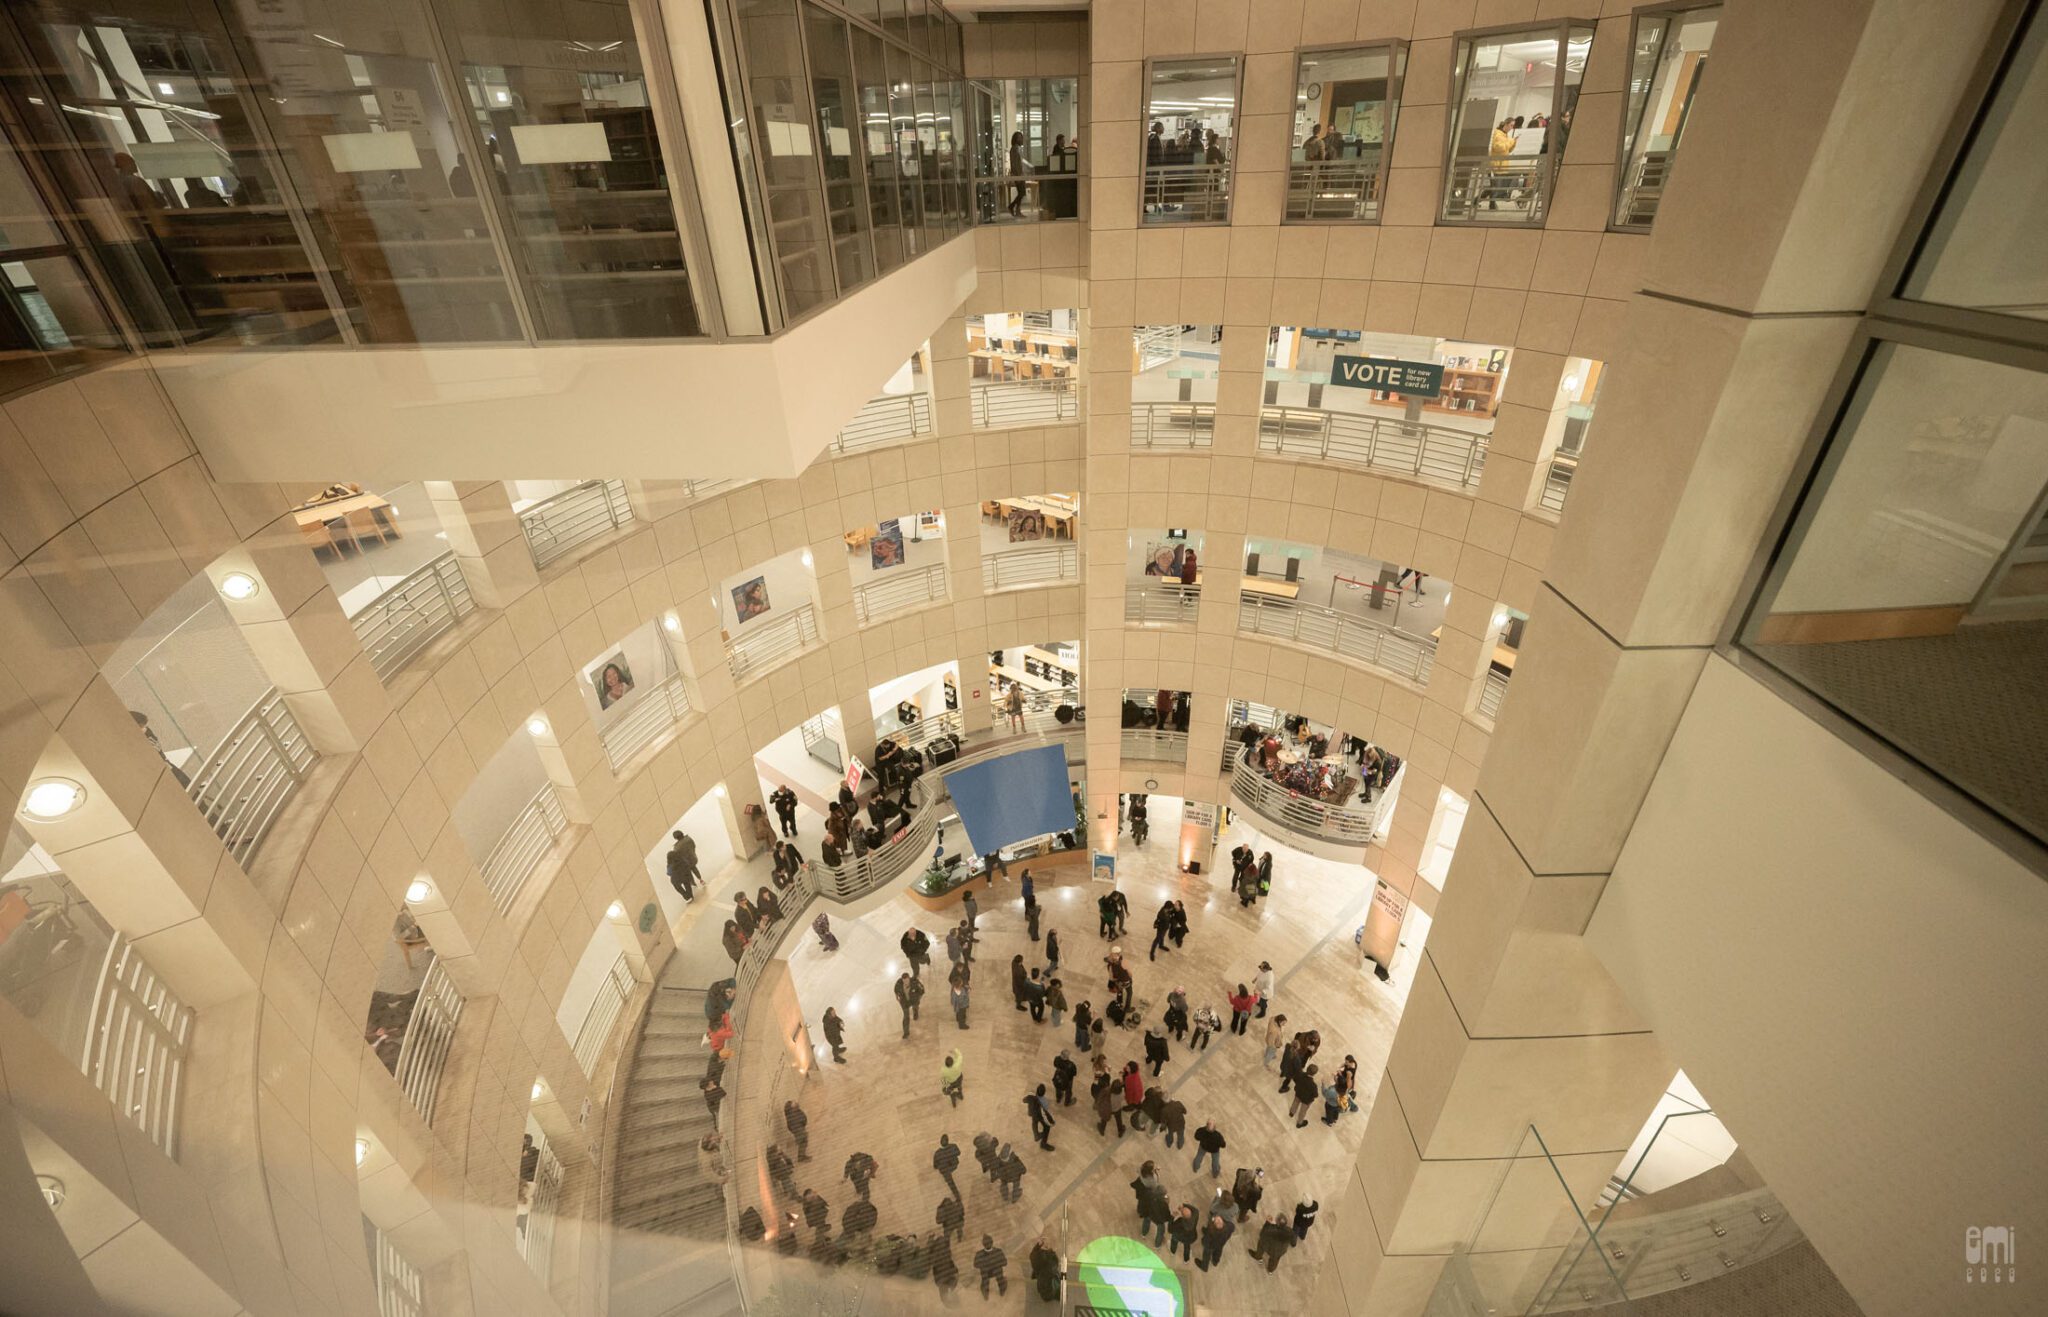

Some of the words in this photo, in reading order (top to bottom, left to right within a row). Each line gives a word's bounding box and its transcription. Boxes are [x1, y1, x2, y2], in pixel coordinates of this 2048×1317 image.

[1343, 362, 1402, 385] VOTE
[1417, 369, 1432, 377] new
[1405, 374, 1427, 384] library
